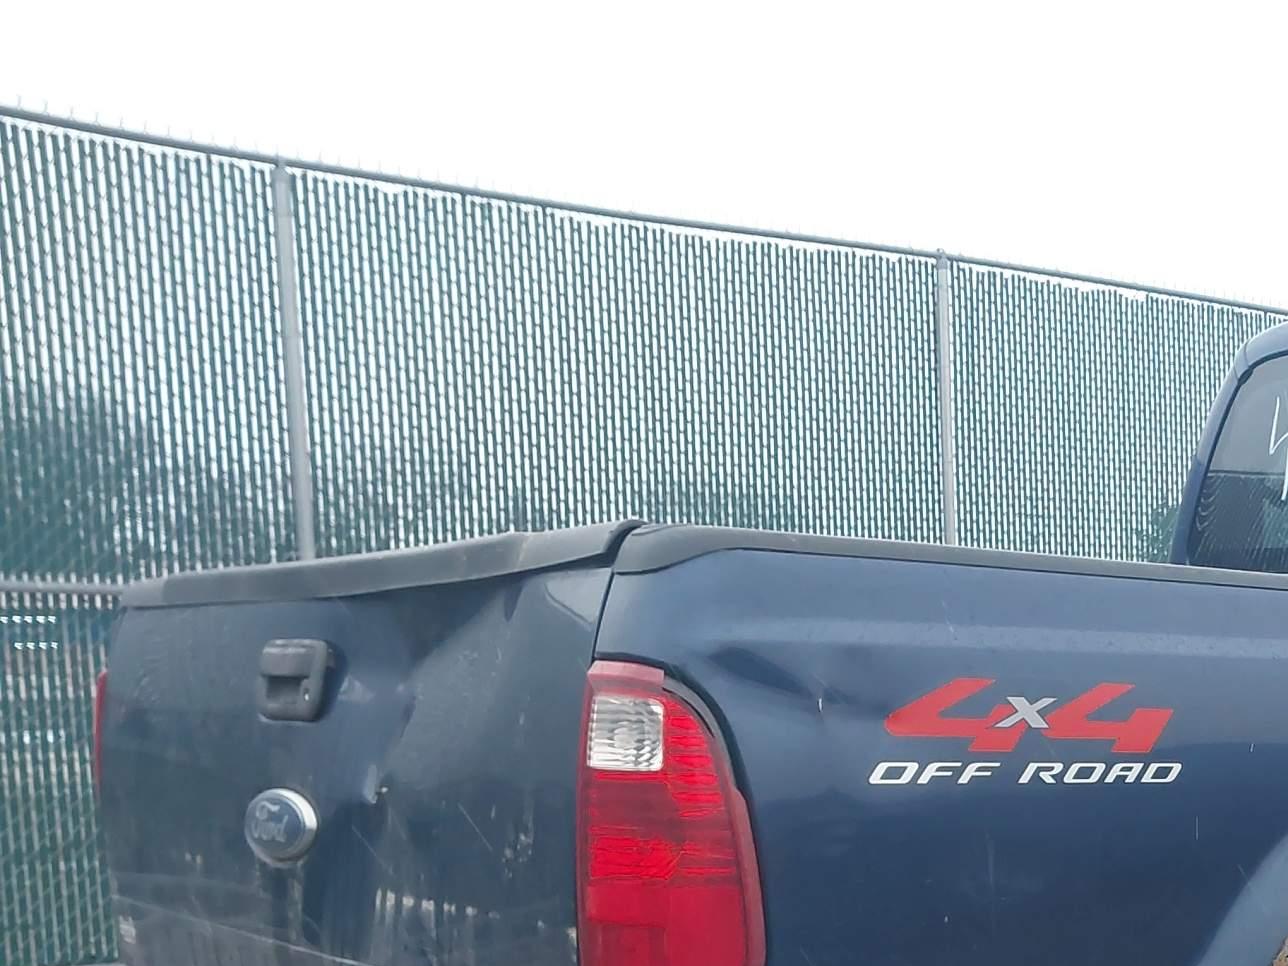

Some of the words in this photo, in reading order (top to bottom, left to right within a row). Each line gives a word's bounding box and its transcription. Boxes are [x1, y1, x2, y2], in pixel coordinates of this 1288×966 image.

[868, 761, 1001, 784] OFF
[1017, 762, 1183, 784] ROAD
[250, 800, 289, 843] Ford
